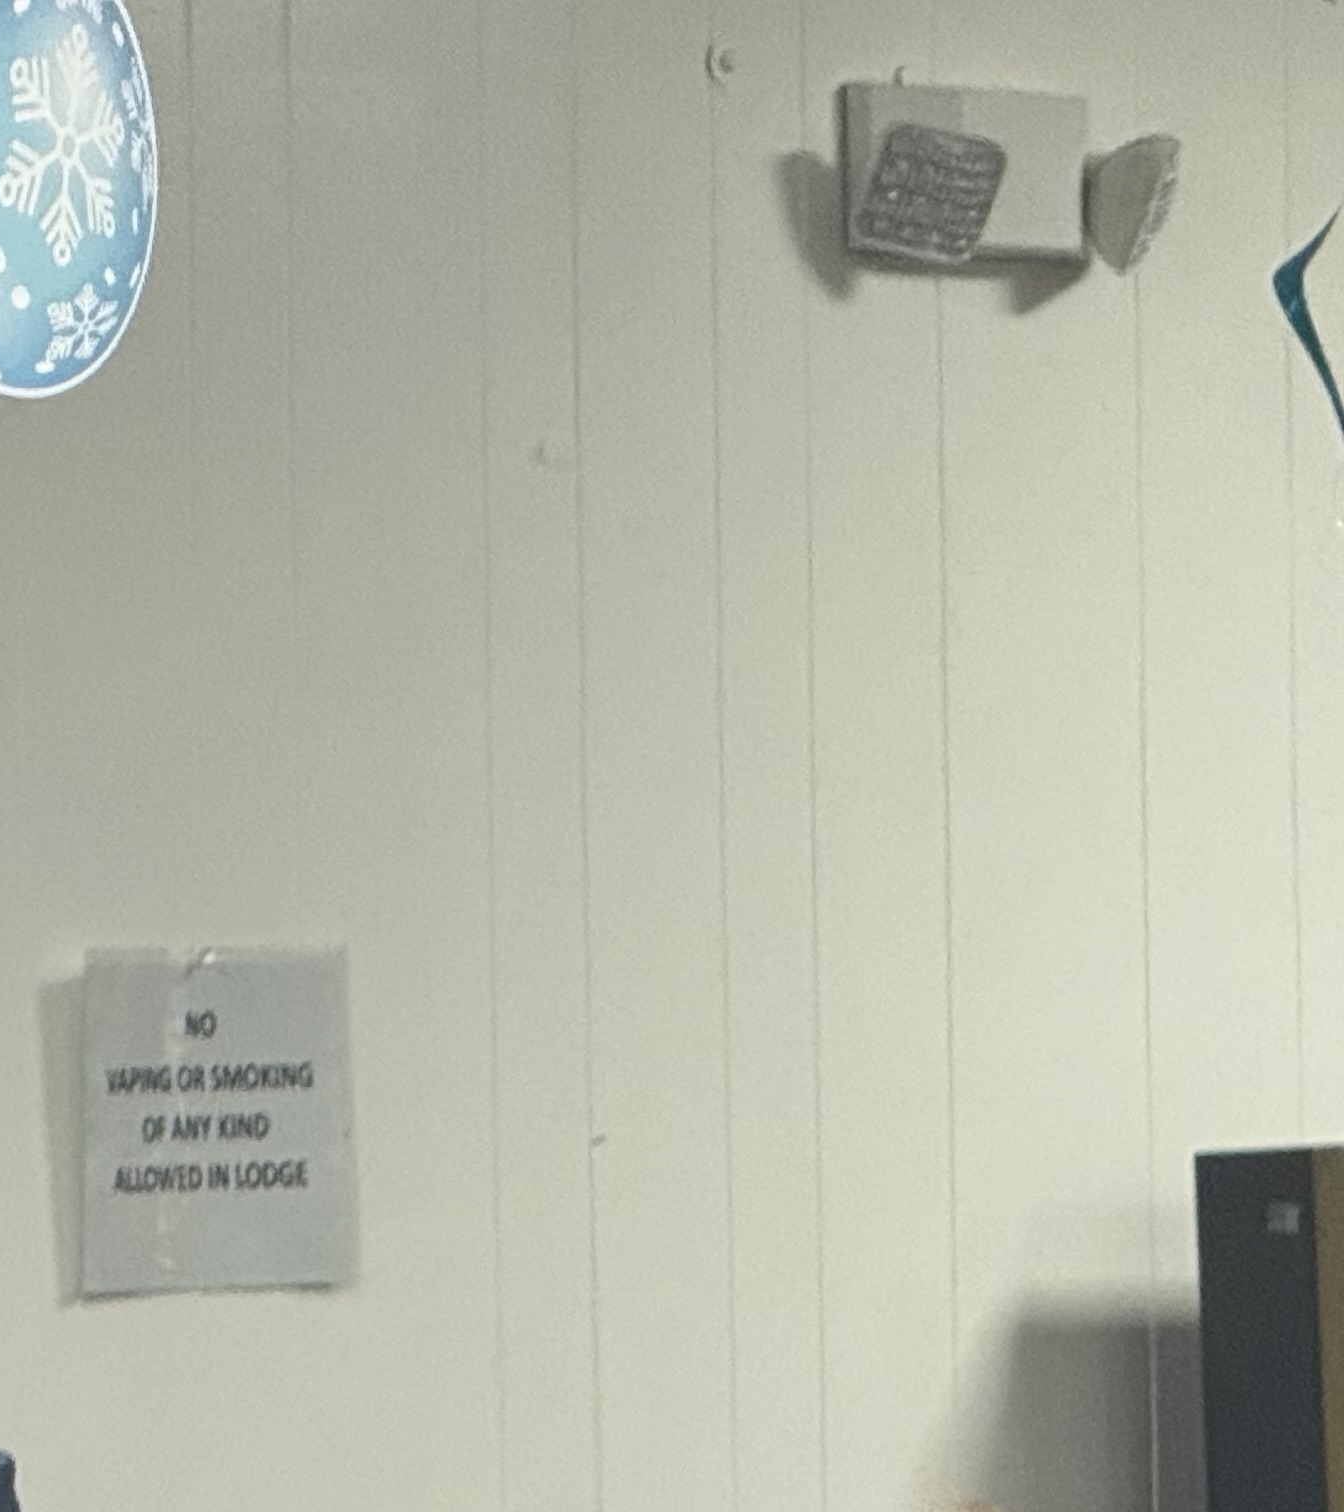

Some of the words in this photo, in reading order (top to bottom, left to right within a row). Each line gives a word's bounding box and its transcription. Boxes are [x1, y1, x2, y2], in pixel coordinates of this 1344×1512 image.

[184, 1010, 216, 1037] NO
[107, 1065, 171, 1094] VAPING
[177, 1065, 204, 1091] OR
[212, 1061, 312, 1090] SMOKING
[143, 1116, 165, 1141] OF
[171, 1114, 212, 1139] ANY
[217, 1113, 269, 1138] KIND
[115, 1164, 202, 1192] ALLOWED
[208, 1164, 230, 1189] IN
[236, 1160, 307, 1187] LODGE
